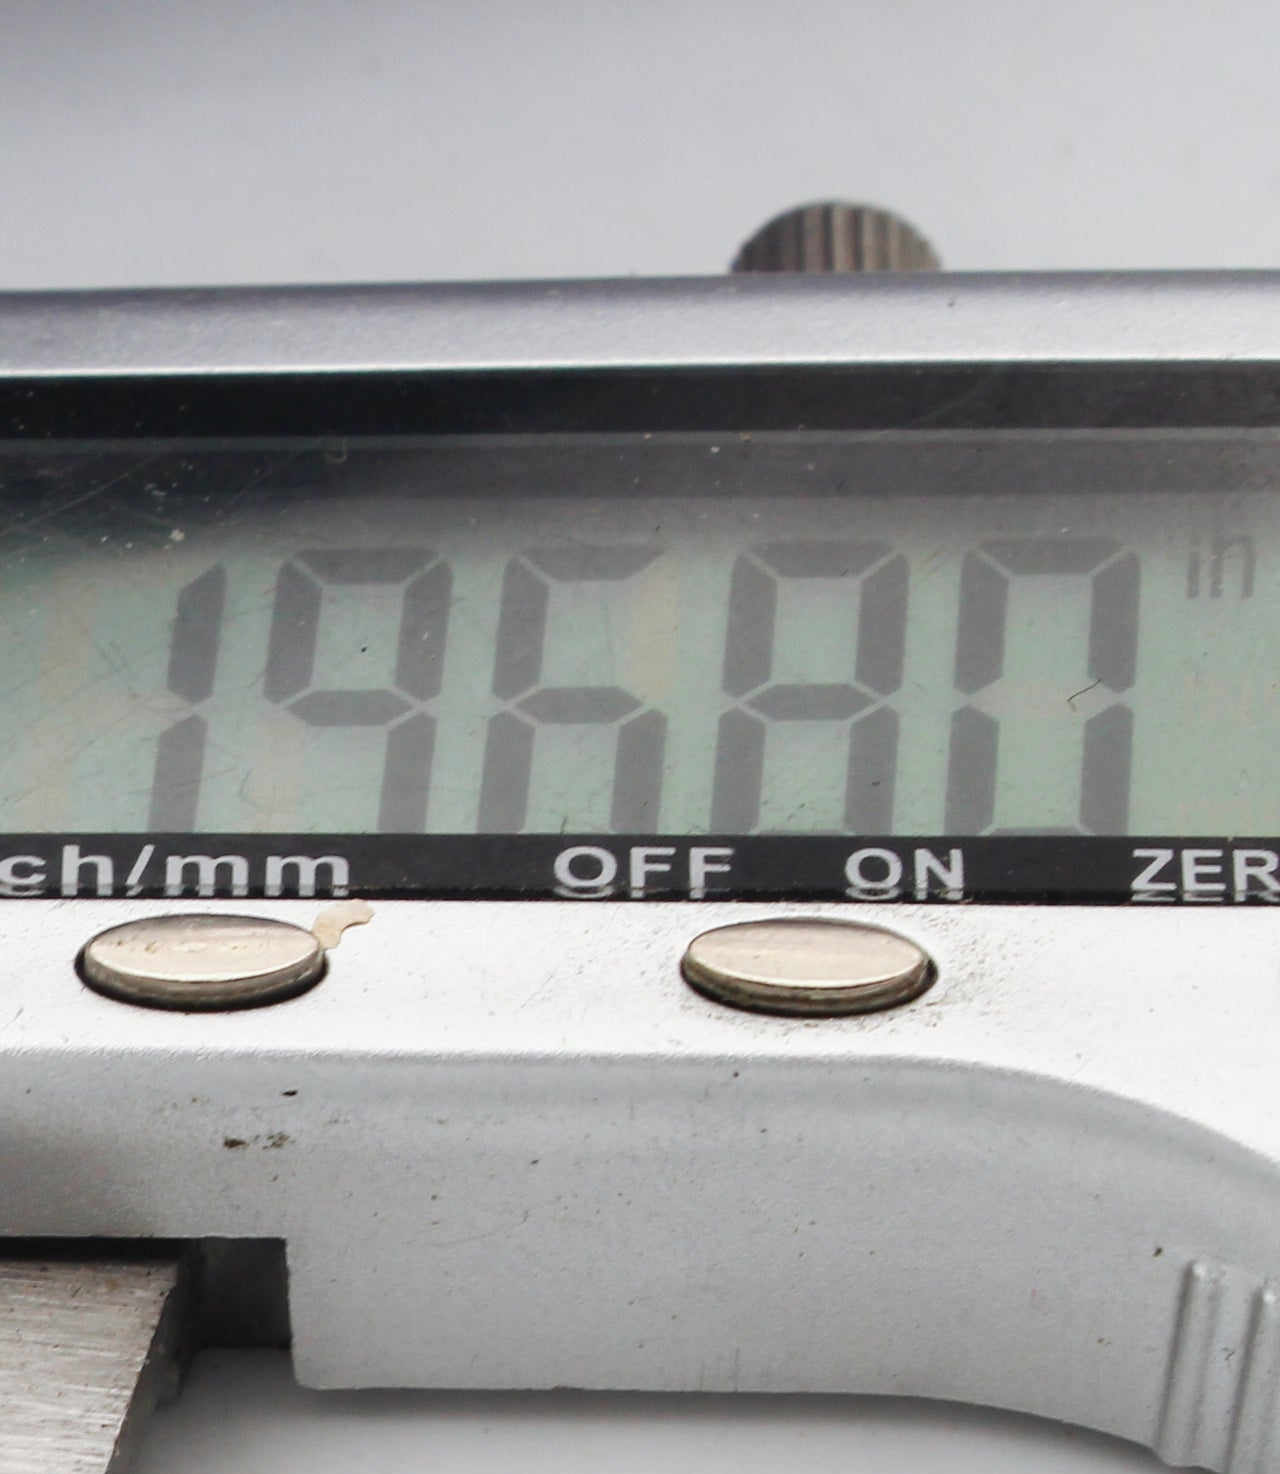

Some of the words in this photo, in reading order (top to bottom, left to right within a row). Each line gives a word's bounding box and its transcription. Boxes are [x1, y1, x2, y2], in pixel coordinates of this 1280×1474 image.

[552, 846, 734, 892] OFF
[844, 846, 967, 893] ON
[1130, 848, 1280, 893] ZER
